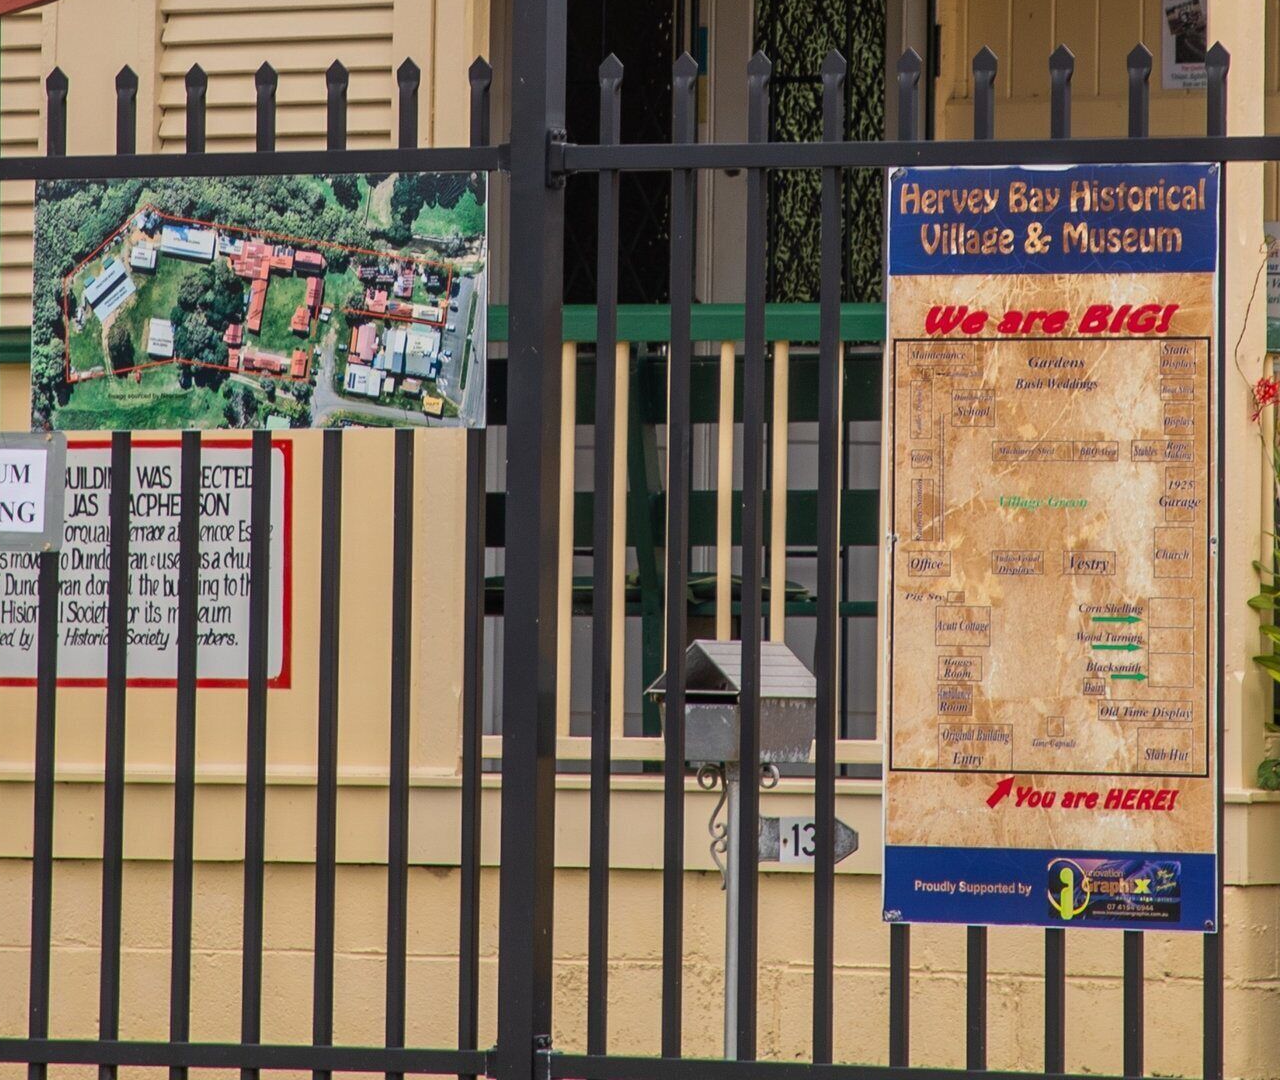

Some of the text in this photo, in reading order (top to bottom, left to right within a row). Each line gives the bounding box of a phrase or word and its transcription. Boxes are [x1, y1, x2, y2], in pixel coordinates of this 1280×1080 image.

[900, 178, 1206, 214] Hervey Bay Historical
[921, 222, 1182, 255] Village & Museum
[925, 304, 1180, 335] We are BIG!
[1028, 356, 1085, 369] Gardens
[1015, 377, 1099, 392] Bush Weddings
[137, 466, 172, 489] WAS
[1168, 480, 1194, 490] 1925
[69, 493, 98, 517] JAS
[999, 495, 1044, 511] Village
[1159, 495, 1201, 509] Garage
[1155, 549, 1190, 560] Church
[910, 558, 944, 571] Office
[1070, 555, 1110, 574] Vestry
[139, 573, 159, 596] the
[224, 573, 237, 596] to
[145, 601, 161, 623] its
[1078, 603, 1144, 615] Corn Shelling
[20, 628, 34, 650] by
[1077, 632, 1144, 644] Wood Turning
[944, 668, 971, 678] Room
[1086, 662, 1141, 673] Blacksmith
[939, 701, 968, 712] Room
[1100, 706, 1192, 720] Old Time Display
[942, 728, 1010, 745] Original Building
[952, 752, 984, 768] Entry
[1144, 748, 1190, 761] Slab Hut
[1015, 786, 1180, 812] You are HERE!
[915, 880, 1032, 897] Proudly Supported by
